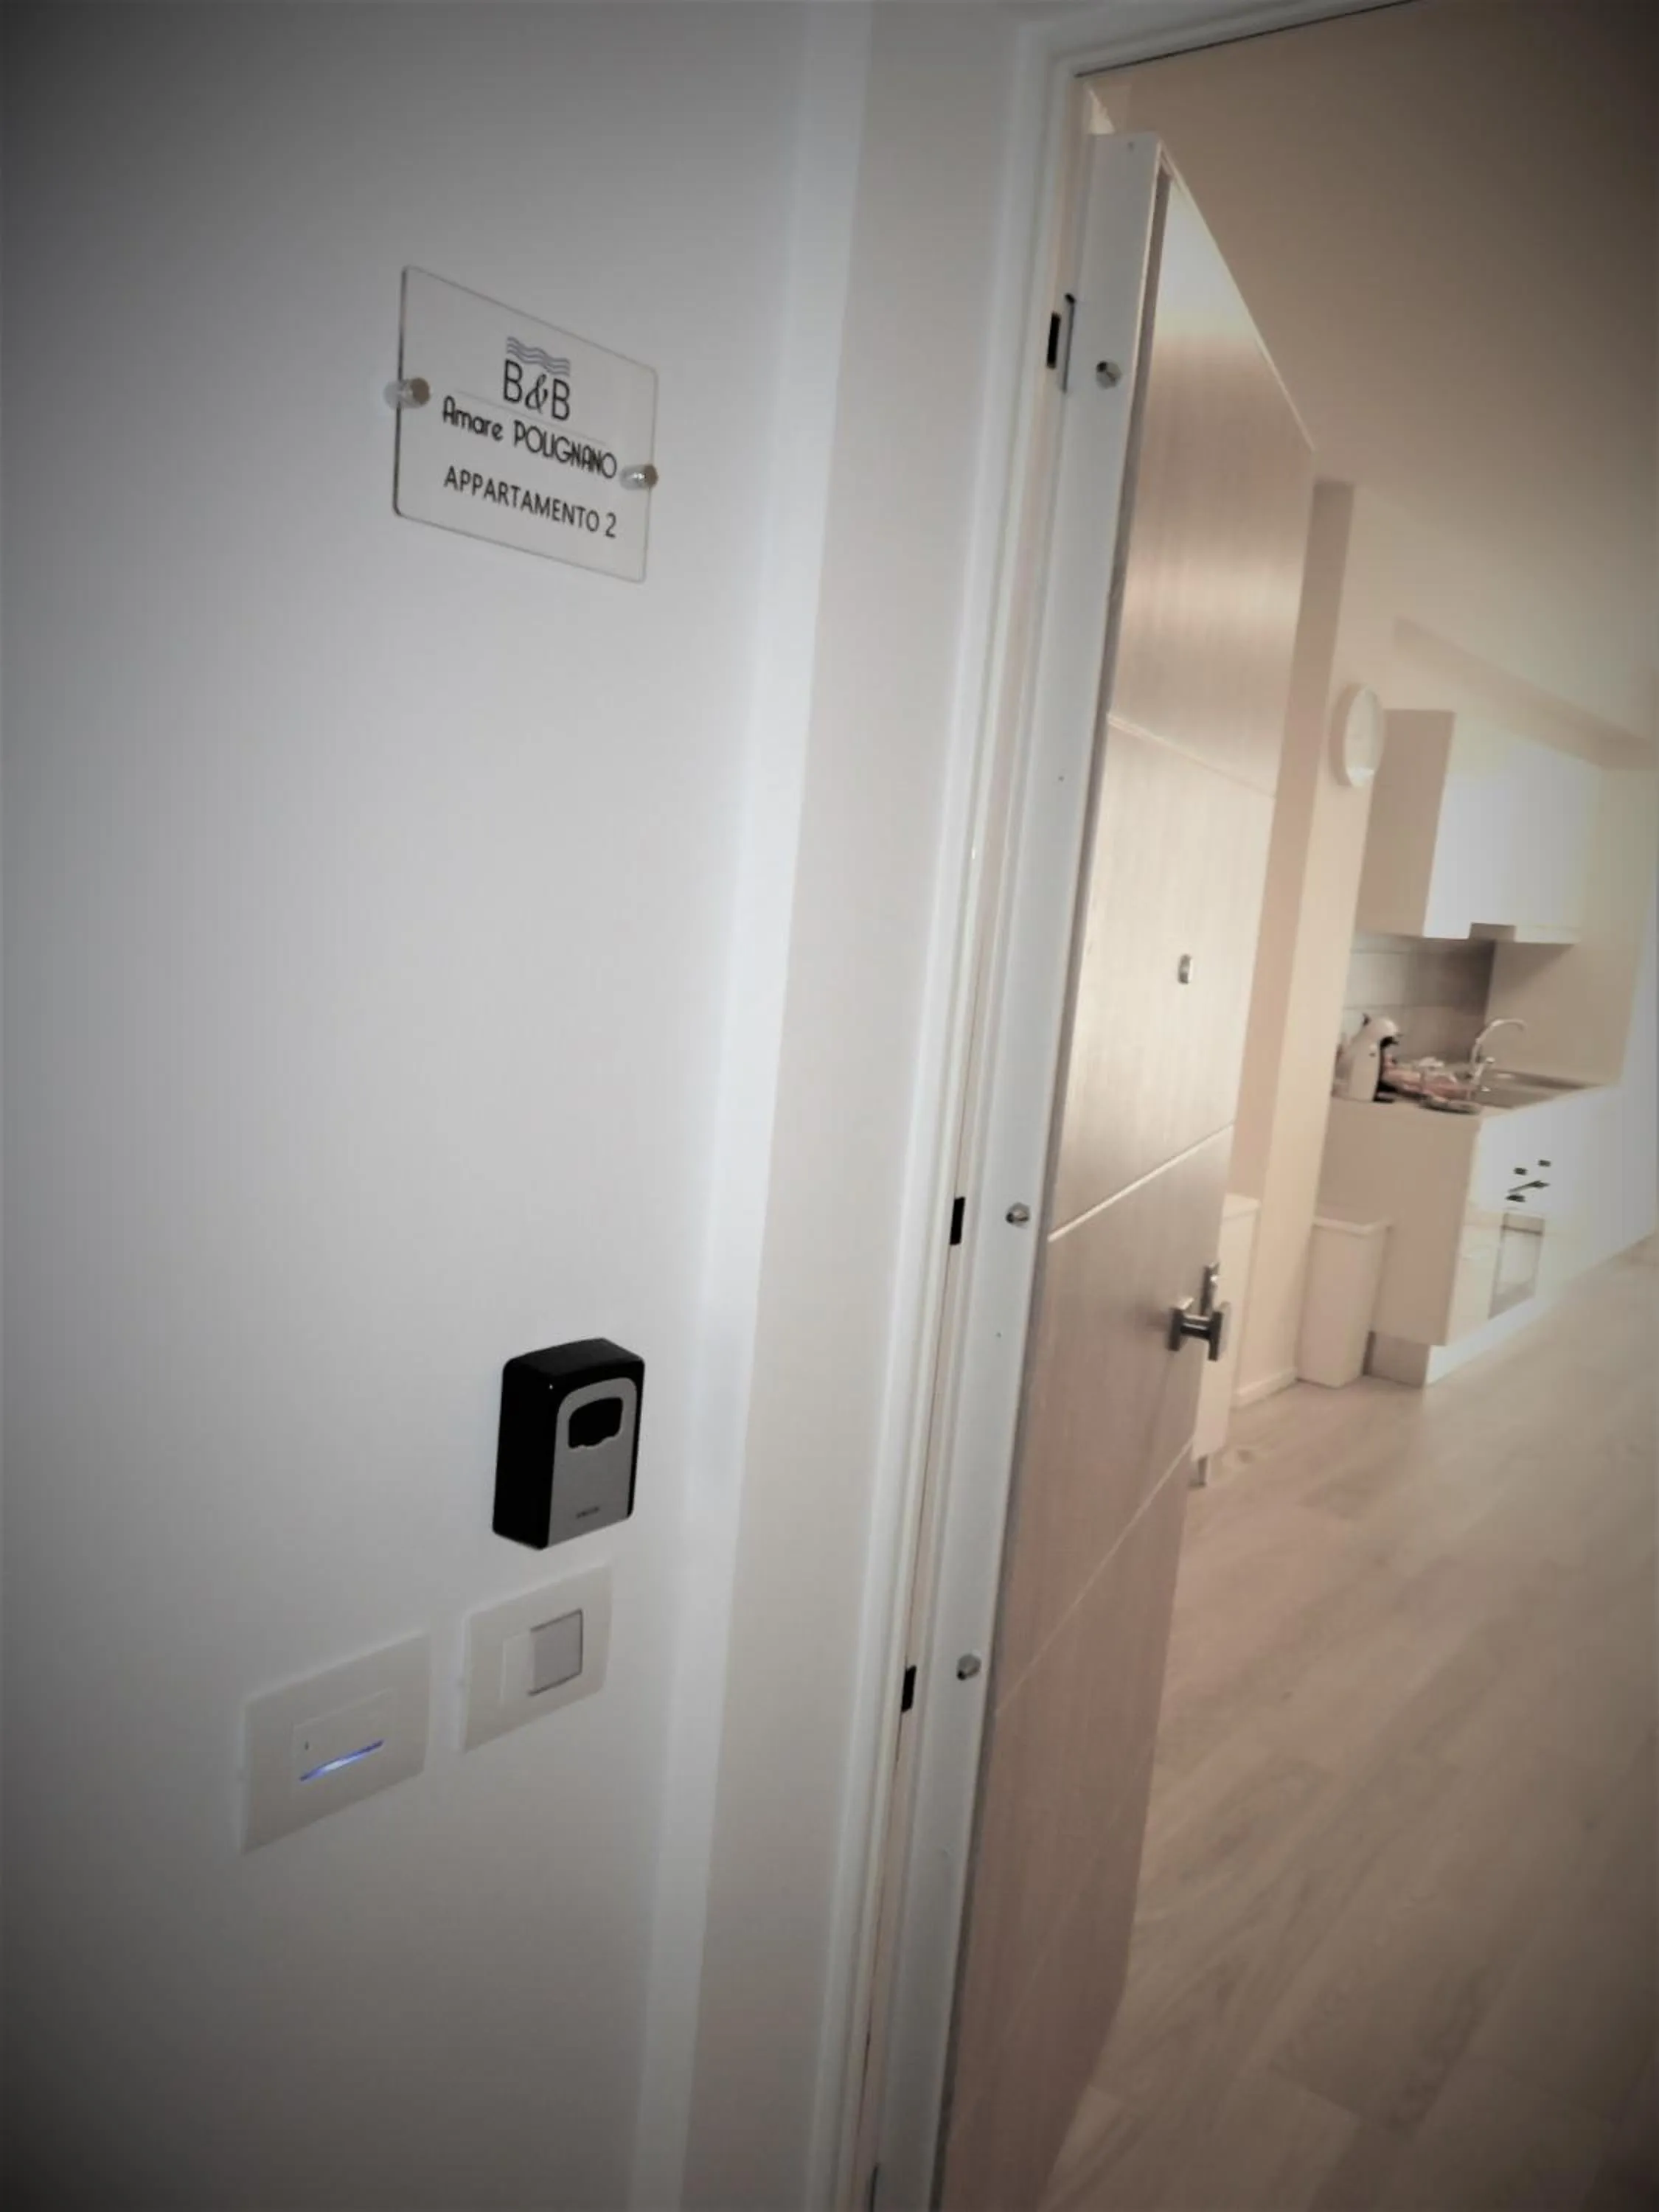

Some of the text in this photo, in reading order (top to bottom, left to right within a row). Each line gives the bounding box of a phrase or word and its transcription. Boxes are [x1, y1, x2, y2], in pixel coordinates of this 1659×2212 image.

[503, 359, 571, 421] B&B
[442, 395, 617, 479] Amare POLIGNANO
[444, 465, 617, 538] APPARTAMENTO 2
